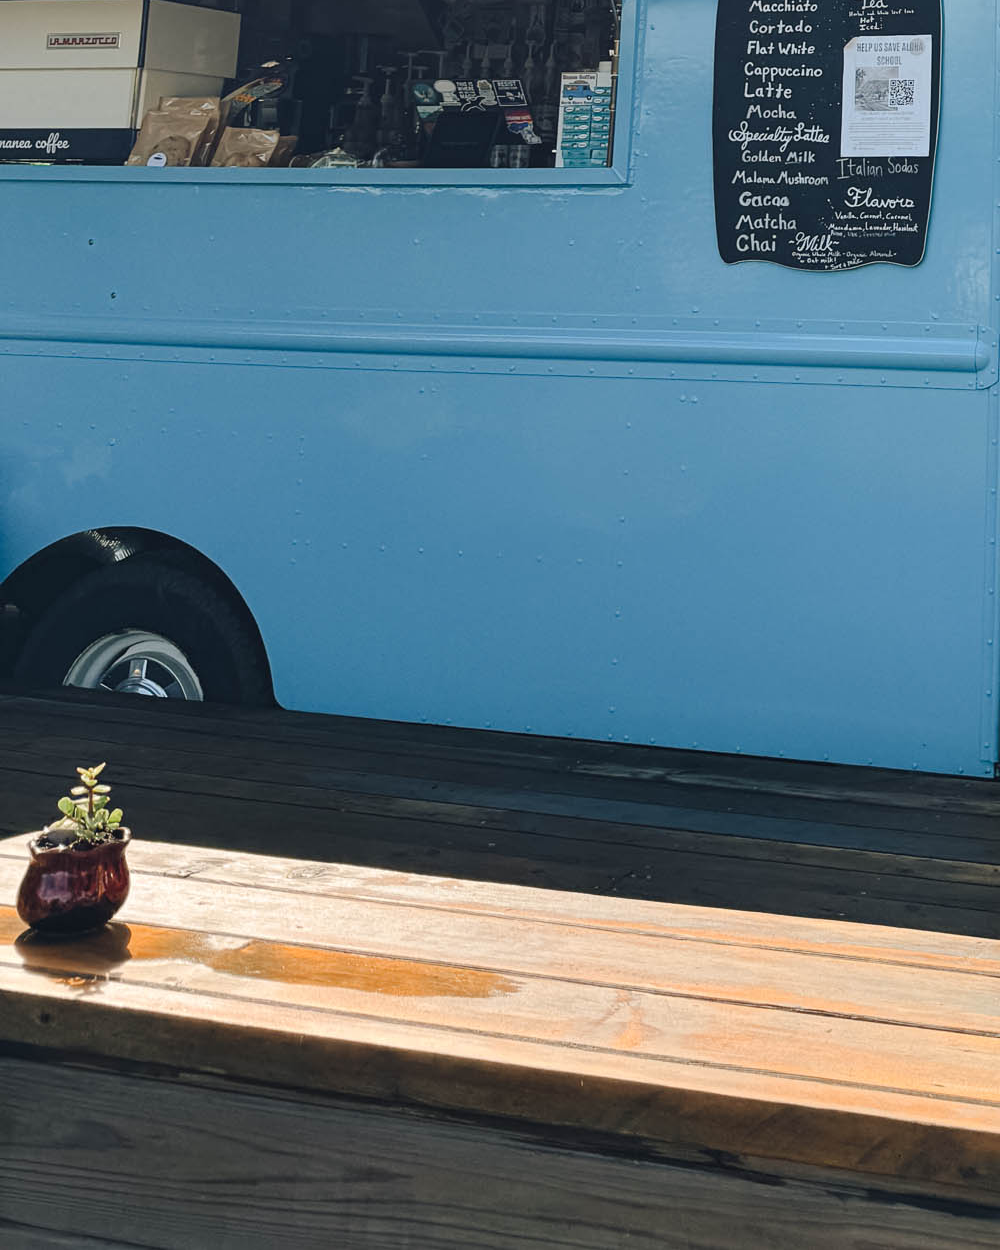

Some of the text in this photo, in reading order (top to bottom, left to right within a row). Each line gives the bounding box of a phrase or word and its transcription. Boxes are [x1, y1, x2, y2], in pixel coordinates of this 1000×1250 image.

[749, 20, 812, 33] Cortado
[860, 15, 874, 23] Hot
[747, 40, 816, 55] Flat White
[744, 61, 823, 83] Cappuccino
[744, 81, 792, 99] Latte
[746, 103, 798, 119] Mocha
[35, 132, 70, 154] coffee
[728, 121, 793, 152] Specialty
[793, 122, 830, 143] Lattes
[741, 150, 815, 163] Golden Milk
[836, 157, 919, 179] Italian Sodas
[732, 170, 829, 185] Malama Mushroom
[844, 186, 916, 208] Flavors
[735, 214, 797, 230] Matcha
[736, 234, 777, 252] Chai
